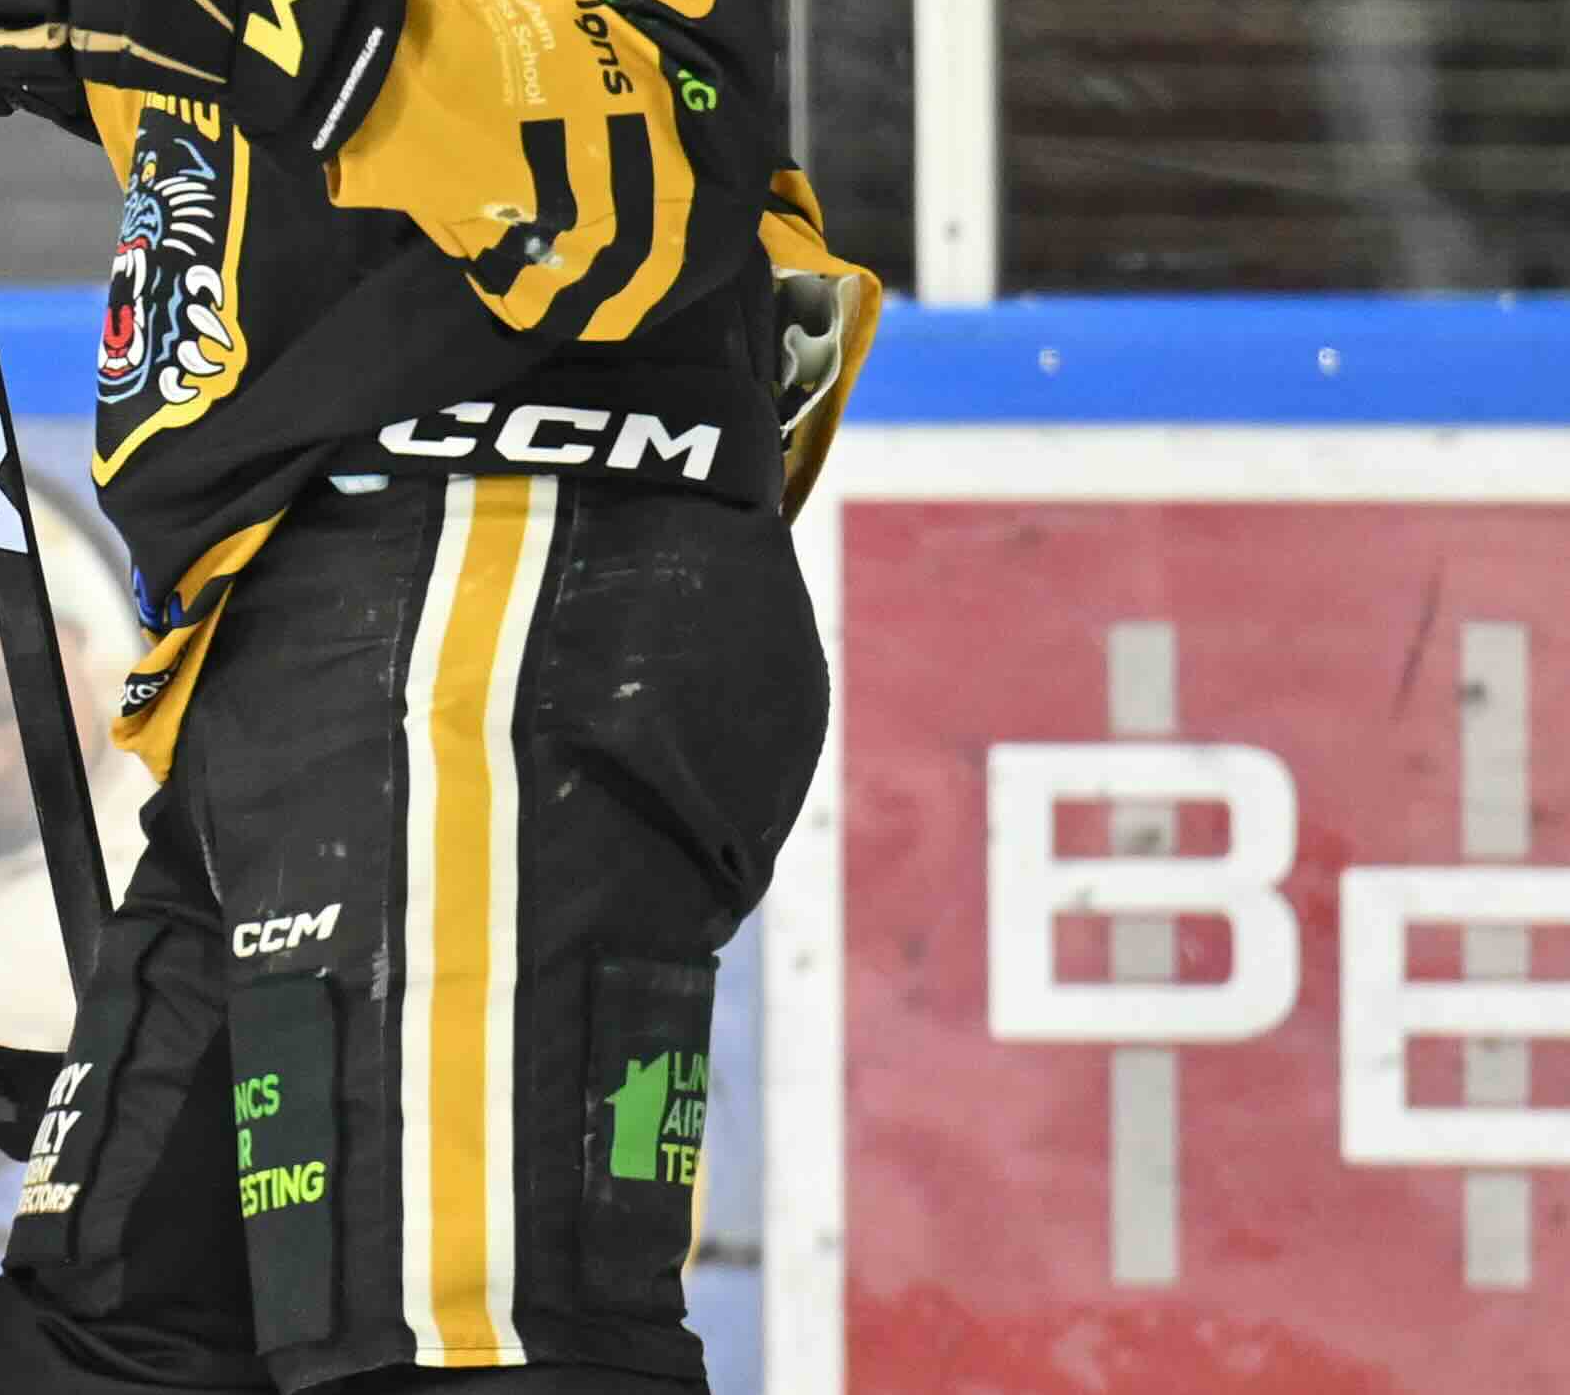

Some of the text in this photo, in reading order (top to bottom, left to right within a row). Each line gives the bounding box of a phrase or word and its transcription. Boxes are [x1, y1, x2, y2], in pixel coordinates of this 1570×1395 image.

[376, 401, 724, 484] CCM
[232, 902, 343, 959] CCM
[234, 1073, 281, 1121] NCS
[240, 1160, 326, 1218] ESTING
